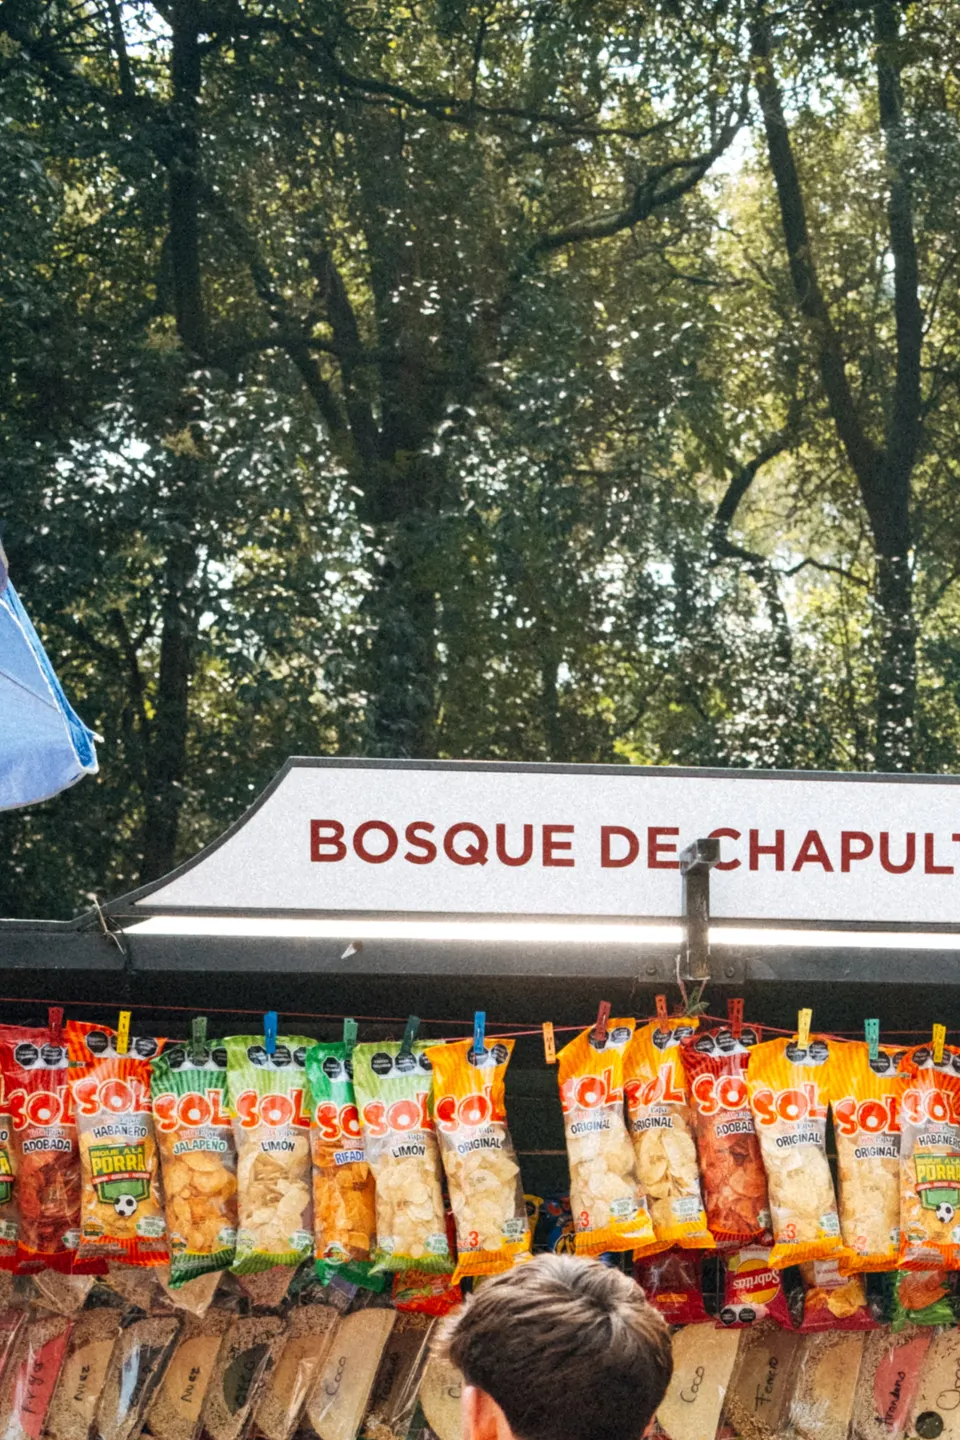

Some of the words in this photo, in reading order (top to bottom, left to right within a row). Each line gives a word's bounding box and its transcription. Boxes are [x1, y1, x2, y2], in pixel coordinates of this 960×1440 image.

[310, 819, 575, 867] BOSQUE
[600, 825, 681, 869] DE
[7, 1086, 76, 1131] SOL
[73, 1076, 152, 1118] SOL
[153, 1088, 233, 1132] SOL
[235, 1088, 312, 1130] SOL
[432, 1085, 506, 1135] SOL
[692, 1072, 749, 1116] SO
[750, 1083, 827, 1126] SOL
[901, 1088, 960, 1126] SOL
[93, 1125, 148, 1139] HABANERO
[315, 1101, 362, 1141] SO
[362, 1092, 434, 1138] SOL
[571, 1118, 611, 1134] ORIGINAL
[833, 1094, 901, 1136] SOL
[23, 1138, 71, 1154] ADOBADA
[173, 1138, 227, 1155] JALAPEÑO
[261, 1138, 296, 1153] LIMÓN
[391, 1144, 427, 1159] LIMÓN
[457, 1137, 502, 1155] ORIGINAL
[776, 1132, 820, 1148] ORIGINAL
[853, 1145, 898, 1160] ORIGINAL
[91, 1153, 147, 1177] PORRA
[468, 1230, 480, 1247] 3
[580, 1211, 590, 1228] 3
[732, 1268, 781, 1291] Sabritas
[324, 1356, 348, 1397] Coco
[680, 1365, 705, 1404] Coco
